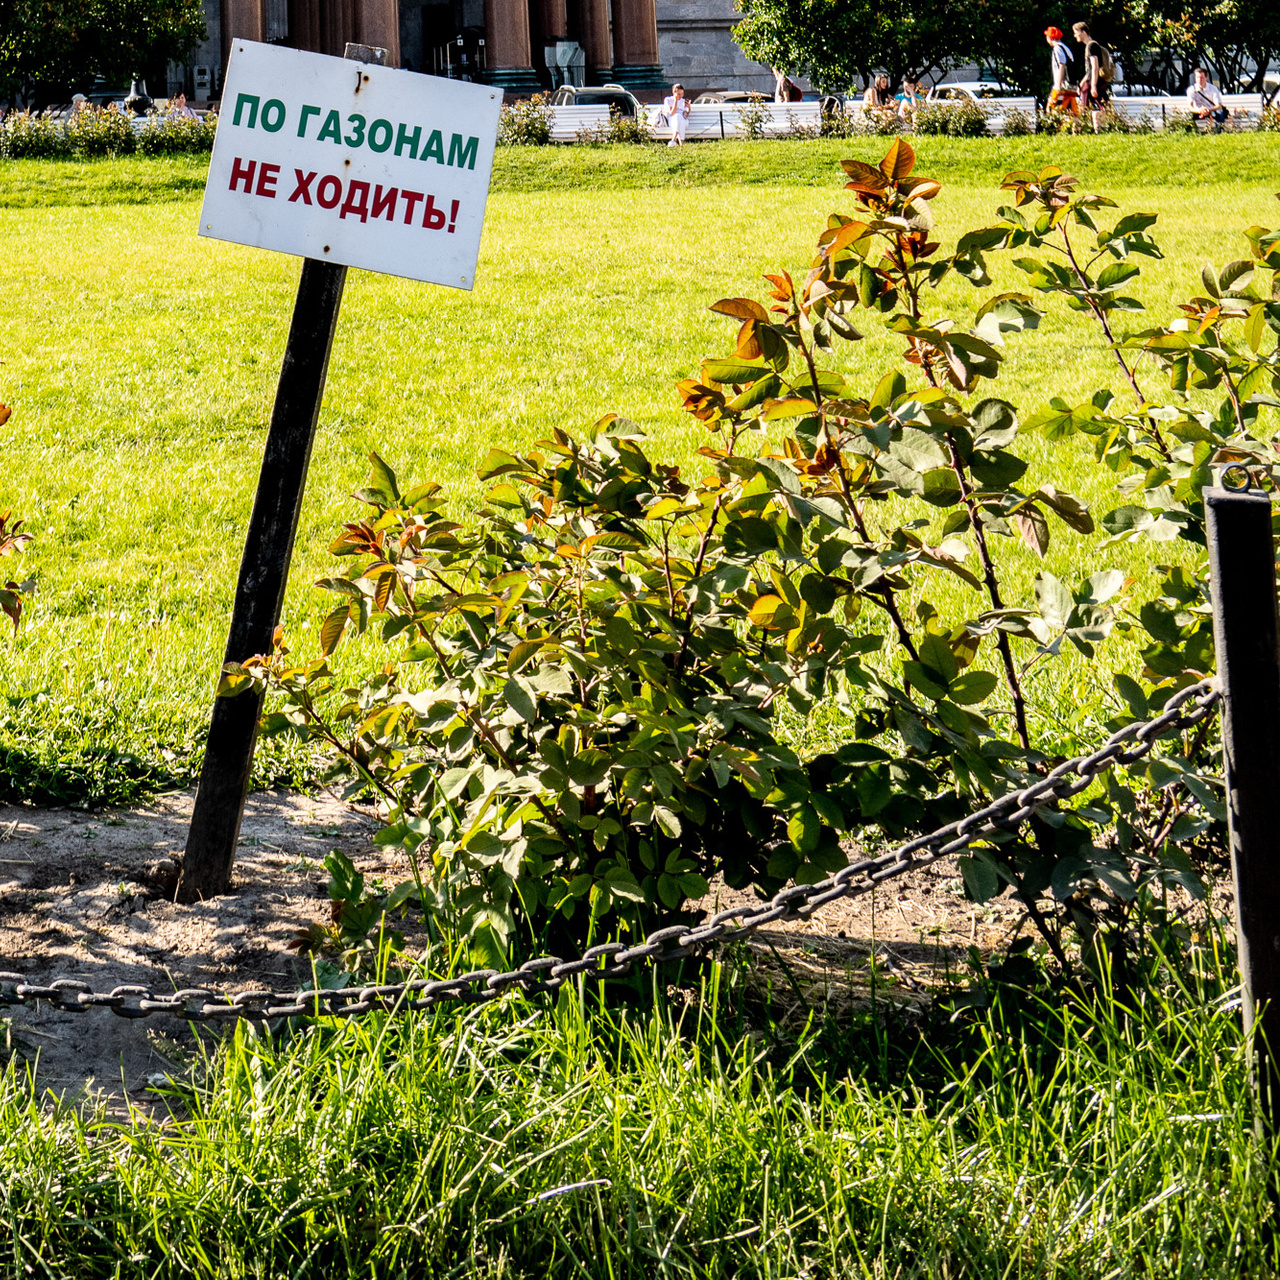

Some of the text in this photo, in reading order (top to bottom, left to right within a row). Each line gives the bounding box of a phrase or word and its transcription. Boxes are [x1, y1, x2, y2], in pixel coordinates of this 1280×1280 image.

[232, 93, 479, 170] ПО ГАЗОНАМ
[228, 157, 460, 233] НЕ ХОДИТЬ!
